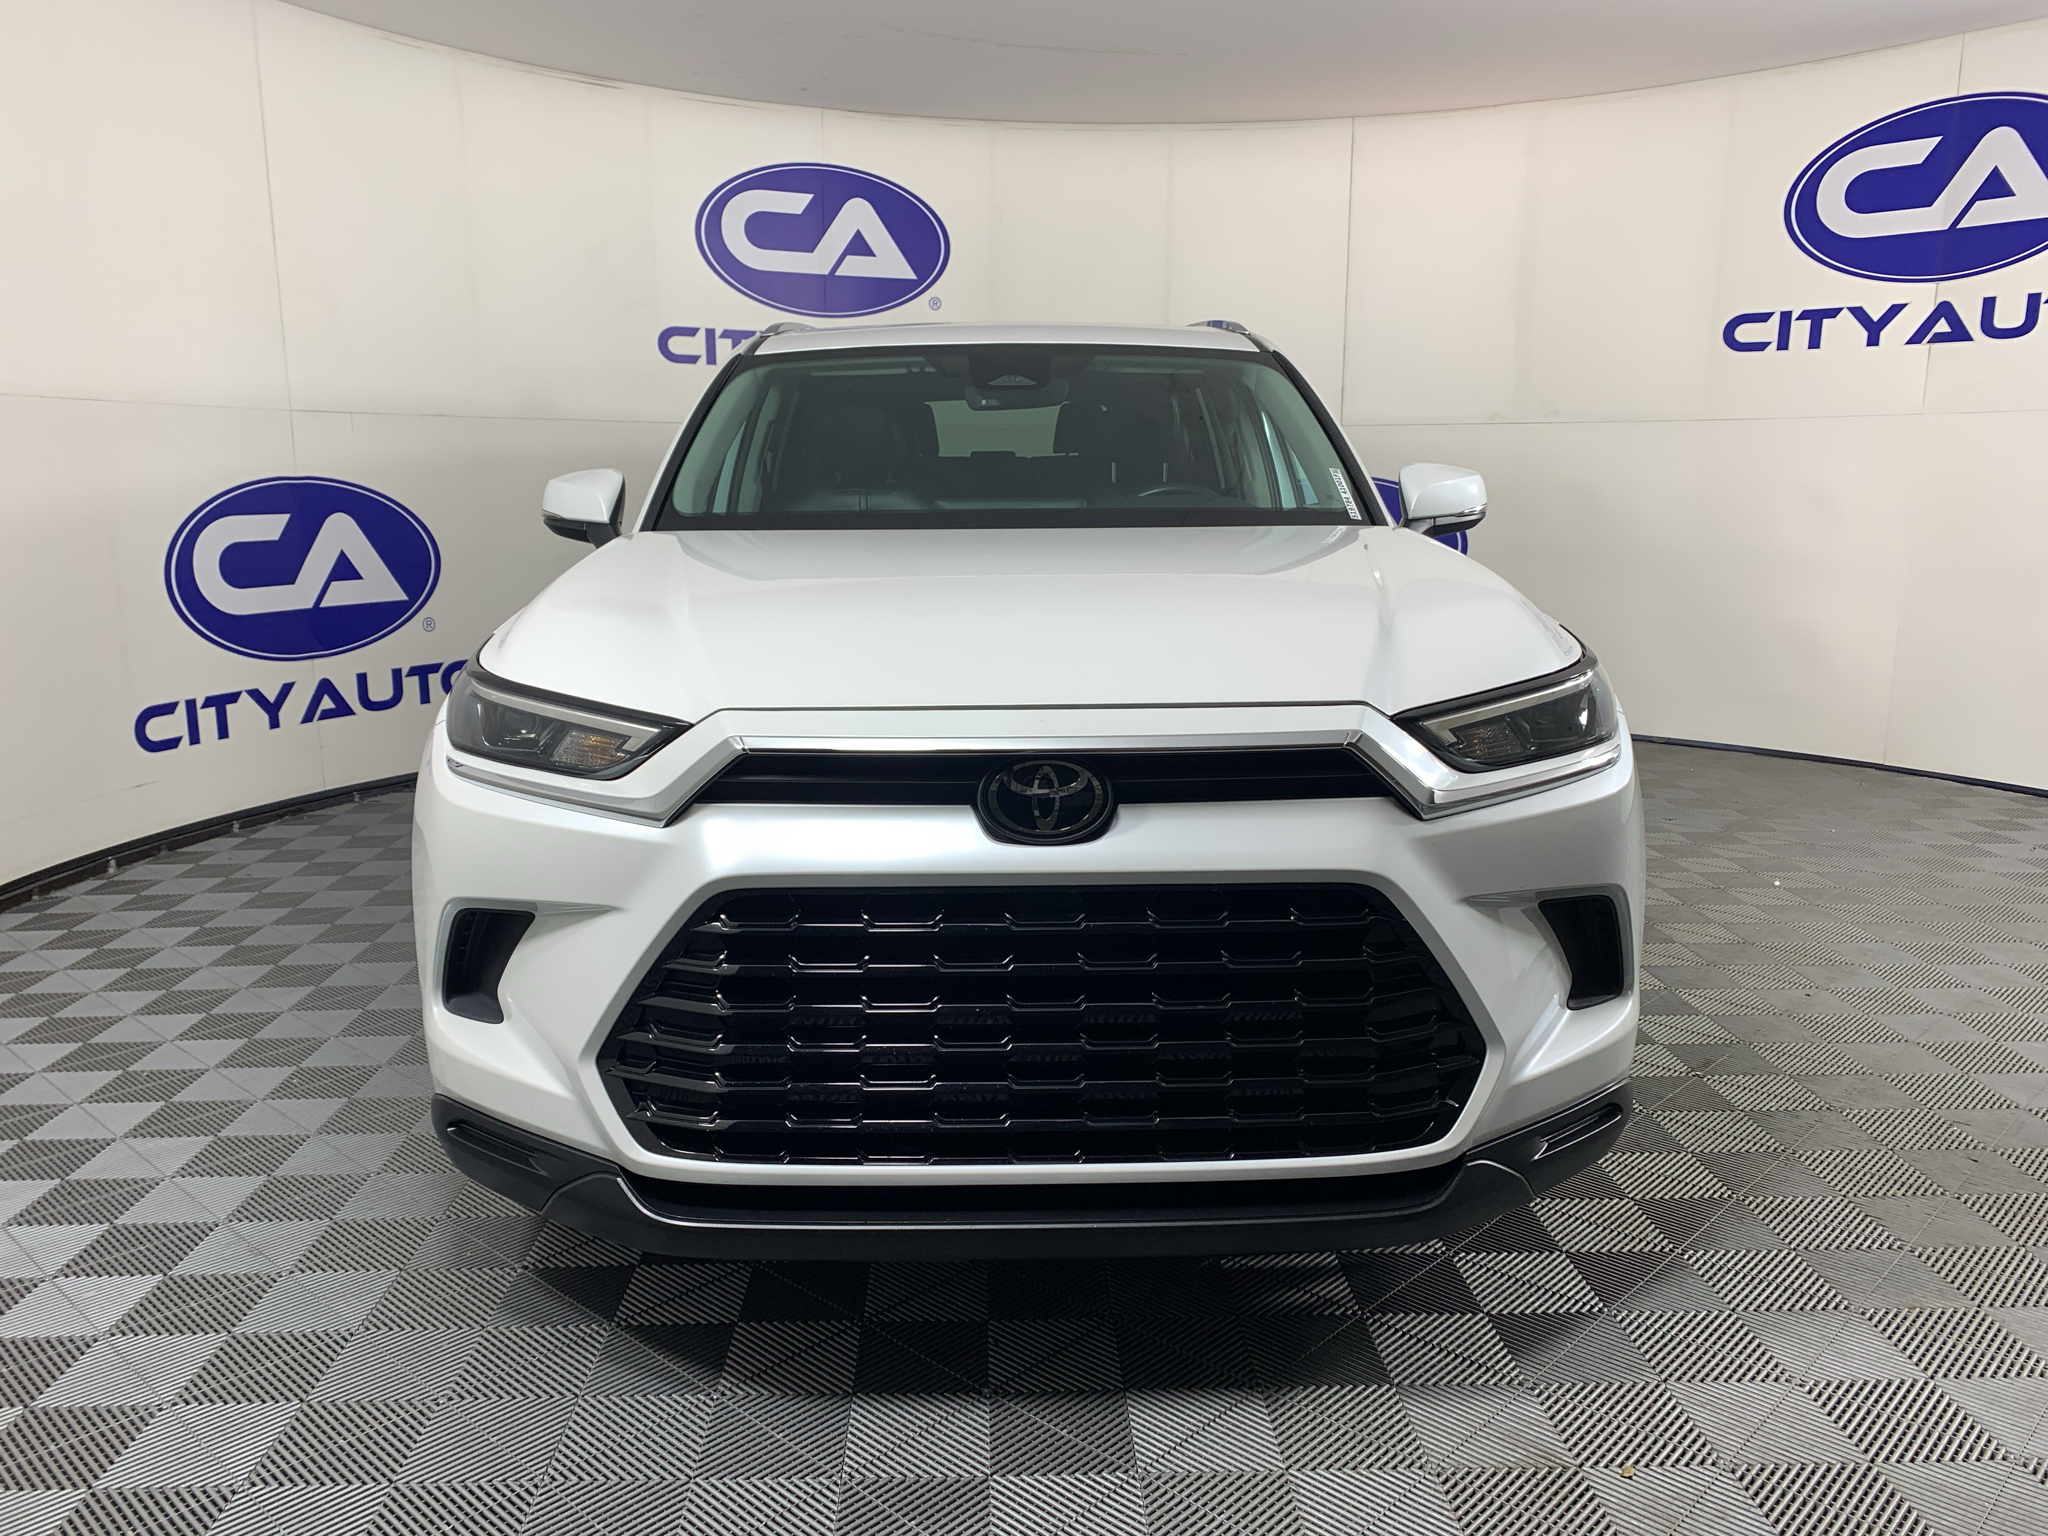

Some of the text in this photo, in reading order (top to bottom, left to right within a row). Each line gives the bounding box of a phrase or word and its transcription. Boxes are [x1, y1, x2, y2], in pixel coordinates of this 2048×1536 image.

[1816, 126, 2048, 239] CA
[721, 189, 918, 280] CA
[1723, 293, 2048, 352] CITYAU
[193, 512, 409, 615] CA
